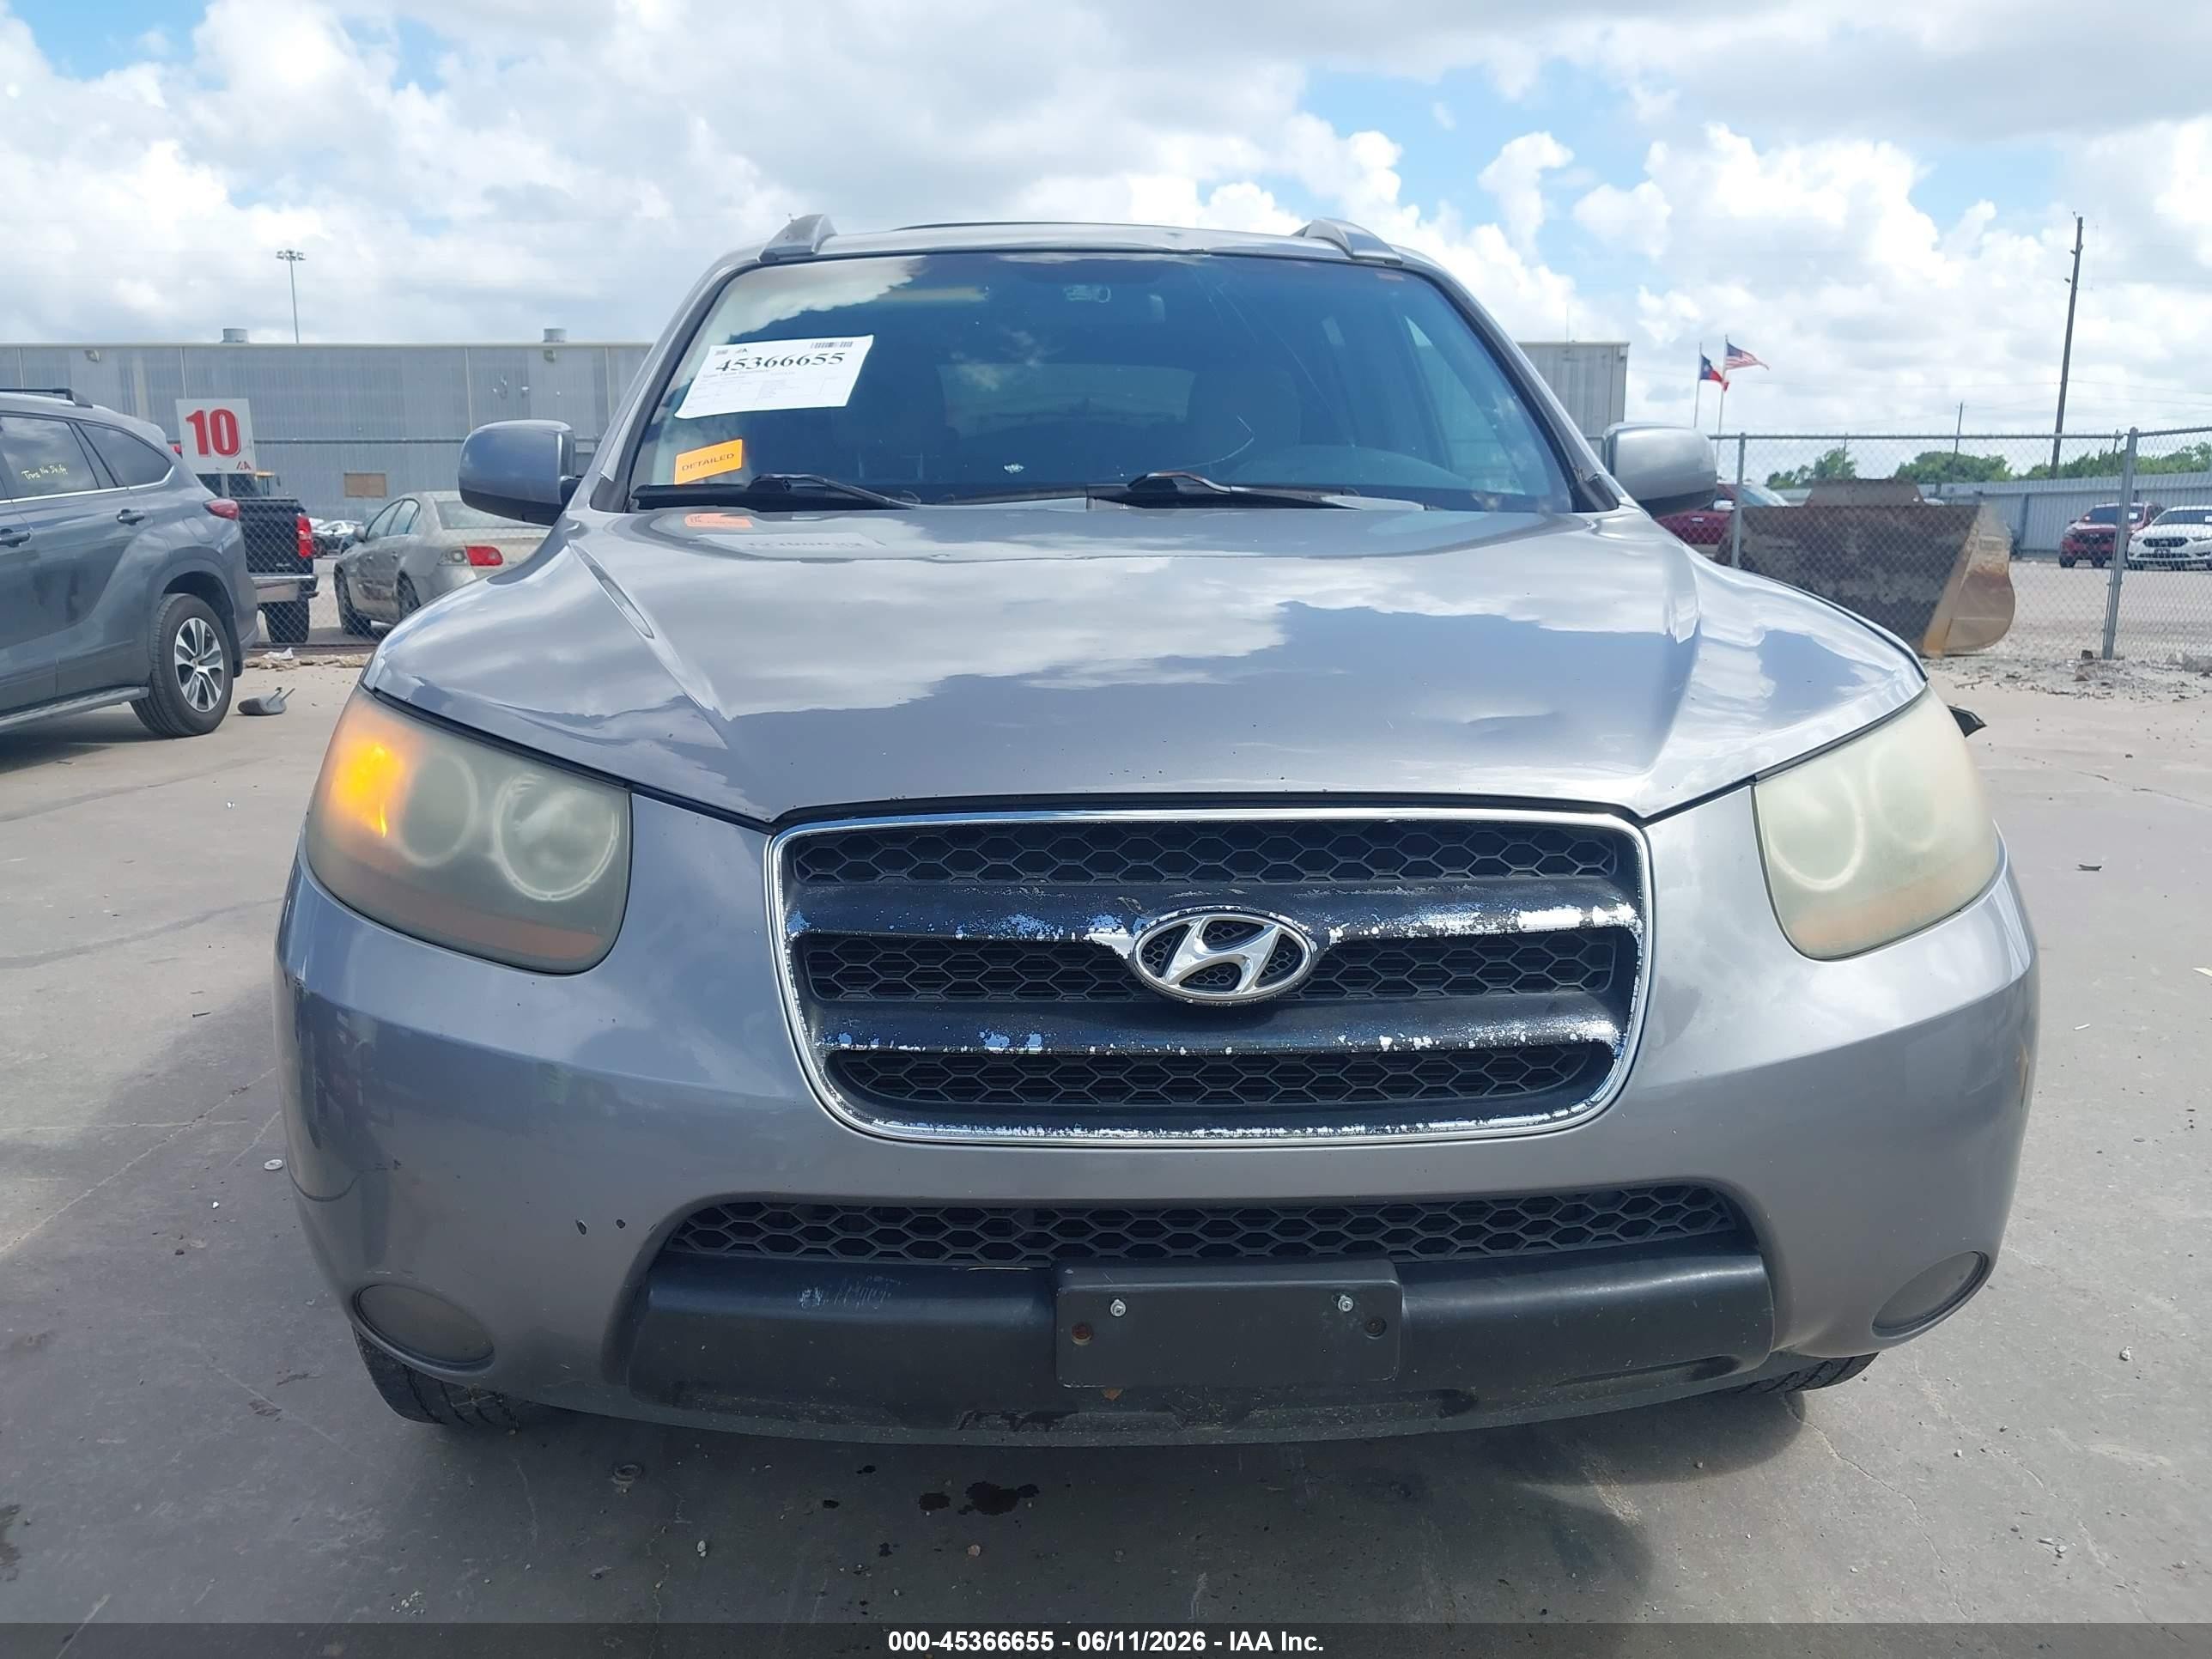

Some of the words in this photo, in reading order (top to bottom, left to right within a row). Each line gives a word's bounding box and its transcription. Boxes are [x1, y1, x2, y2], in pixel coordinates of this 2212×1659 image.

[716, 352, 846, 371] 45366655
[186, 410, 241, 457] 10
[681, 453, 735, 472] DETAILED
